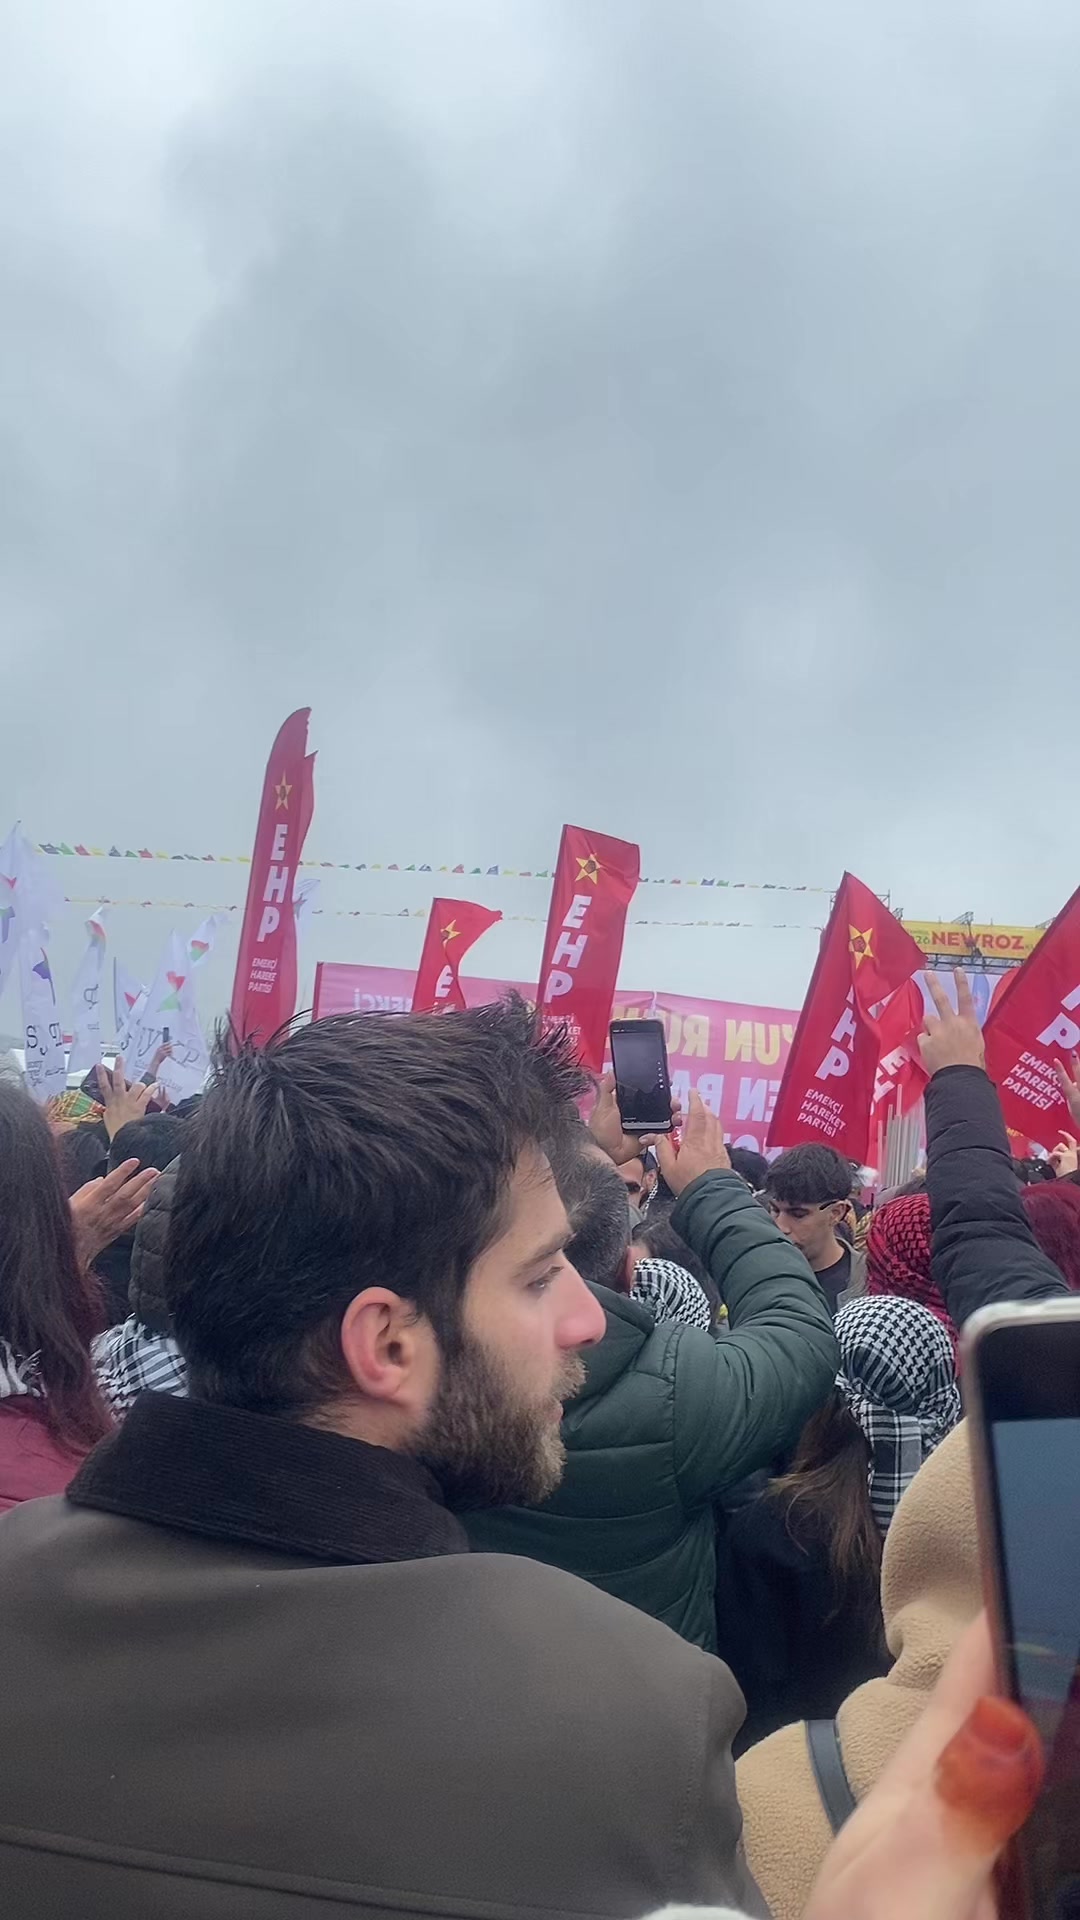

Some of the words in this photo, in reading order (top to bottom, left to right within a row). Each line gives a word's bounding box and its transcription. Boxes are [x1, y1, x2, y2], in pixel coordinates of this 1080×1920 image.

[257, 824, 289, 942] EHP
[544, 894, 592, 1003] EHP
[931, 931, 1024, 950] NEWROZ
[1010, 1064, 1066, 1105] HAREKET
[1018, 1051, 1062, 1087] EMEKÇ
[804, 1088, 844, 1114] EMEKÇİ
[1002, 1077, 1053, 1111] PARTİSİ
[796, 1113, 836, 1138] PARTİSİ
[800, 1101, 846, 1131] HAREKET
